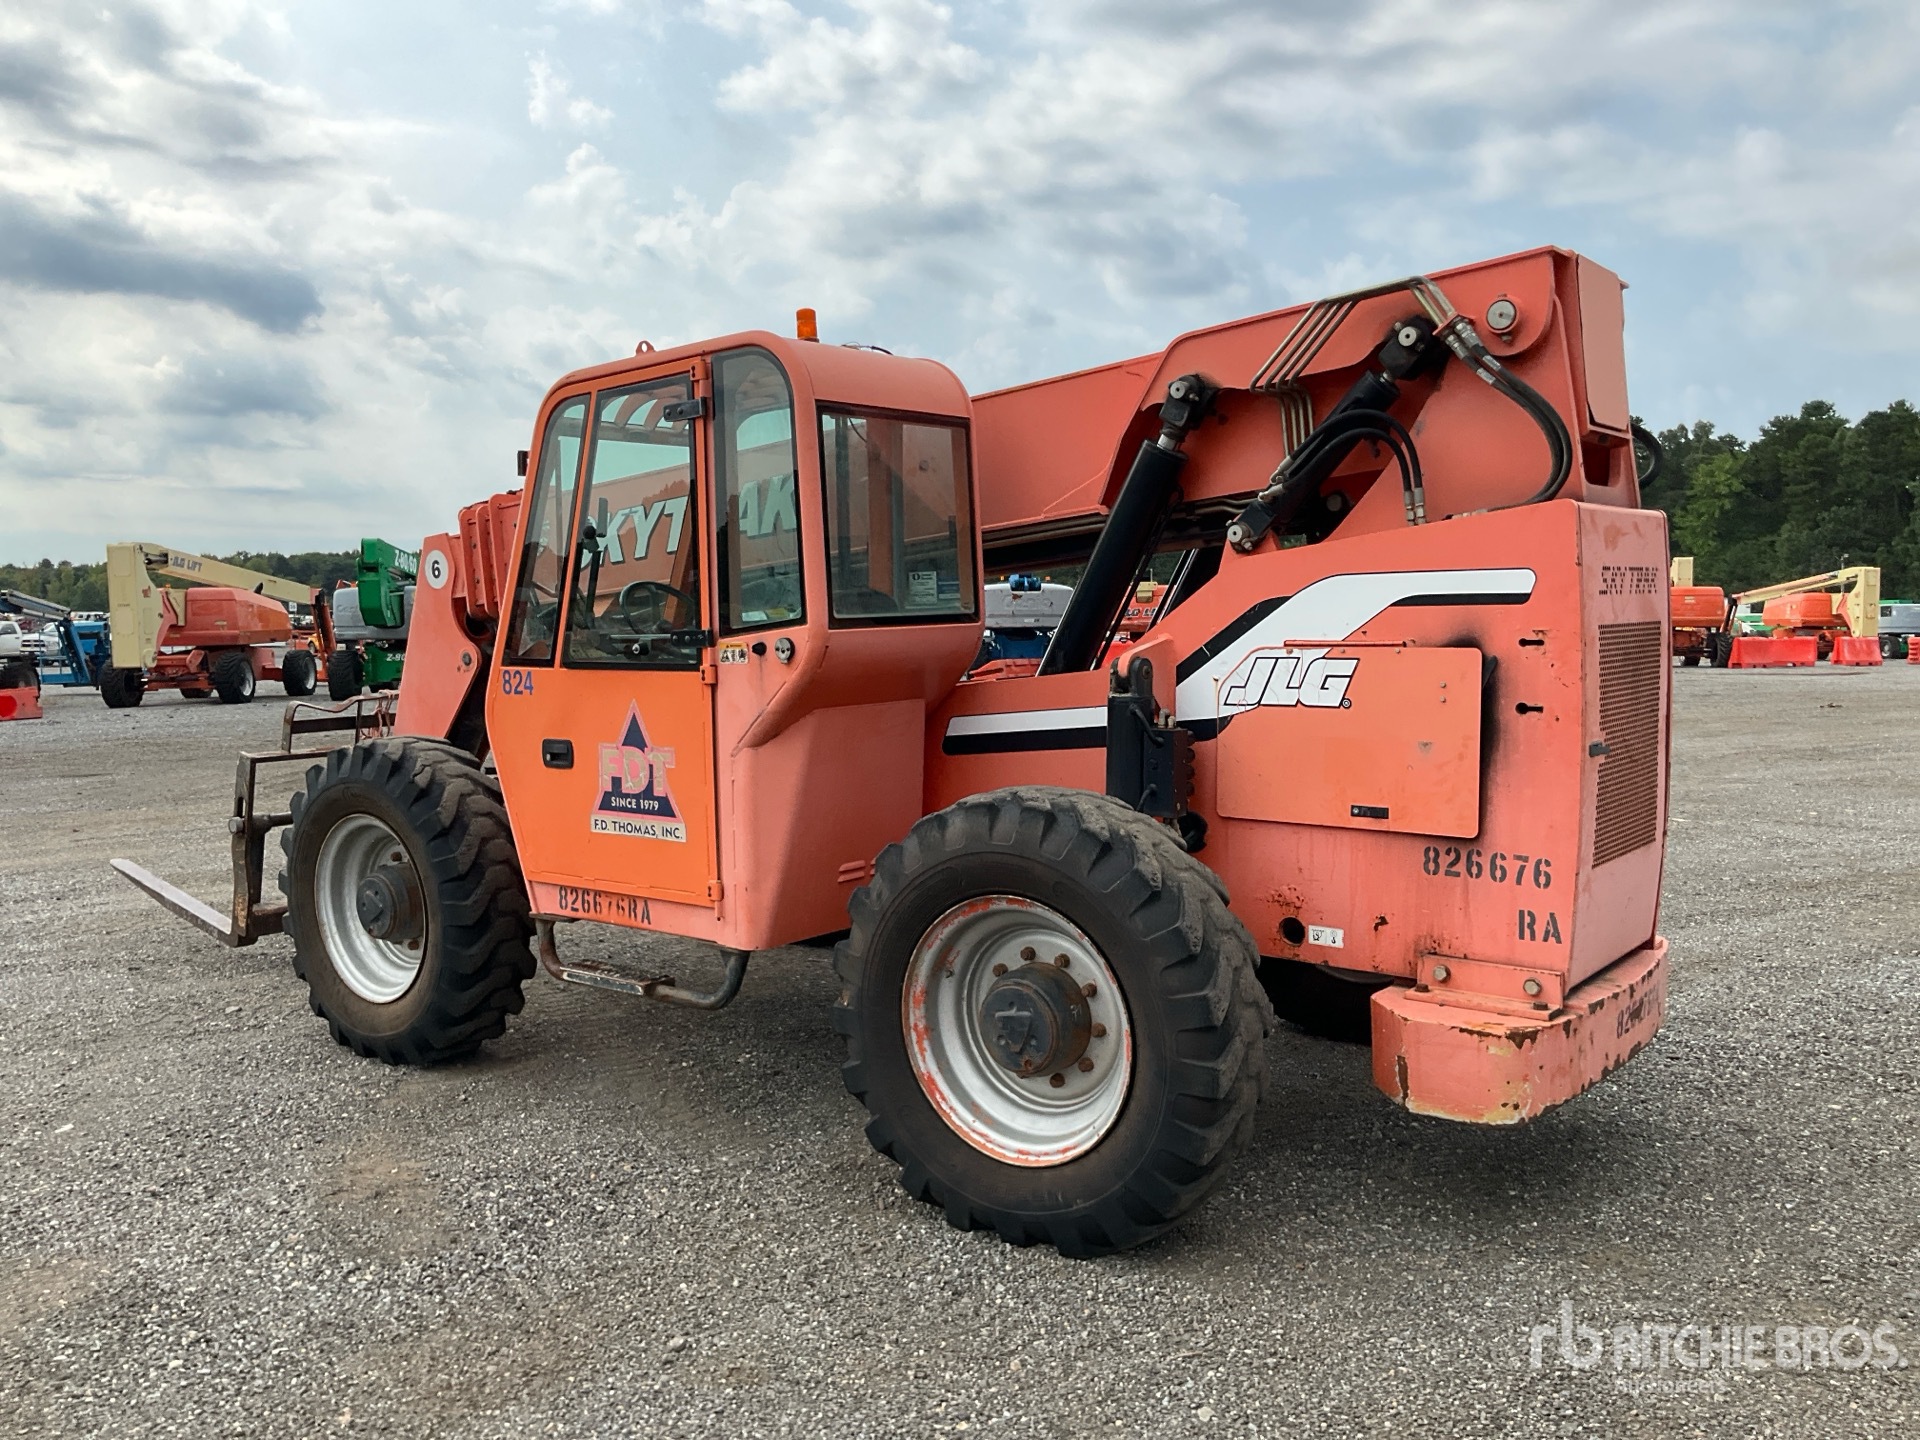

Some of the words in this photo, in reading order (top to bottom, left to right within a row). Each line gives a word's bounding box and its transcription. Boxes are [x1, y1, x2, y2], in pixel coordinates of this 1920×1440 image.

[173, 555, 186, 569] JLG
[187, 559, 203, 573] LIFT
[431, 560, 441, 579] 6
[502, 669, 534, 696] 824
[1223, 656, 1361, 709] JLG
[600, 744, 676, 796] FDT
[611, 796, 637, 809] SINCE
[640, 799, 659, 812] 1979
[611, 821, 659, 839] THOMAS,
[661, 826, 683, 840] INC.
[1423, 846, 1552, 889] 826676
[558, 886, 652, 925] 826676RA
[1518, 909, 1562, 944] RA
